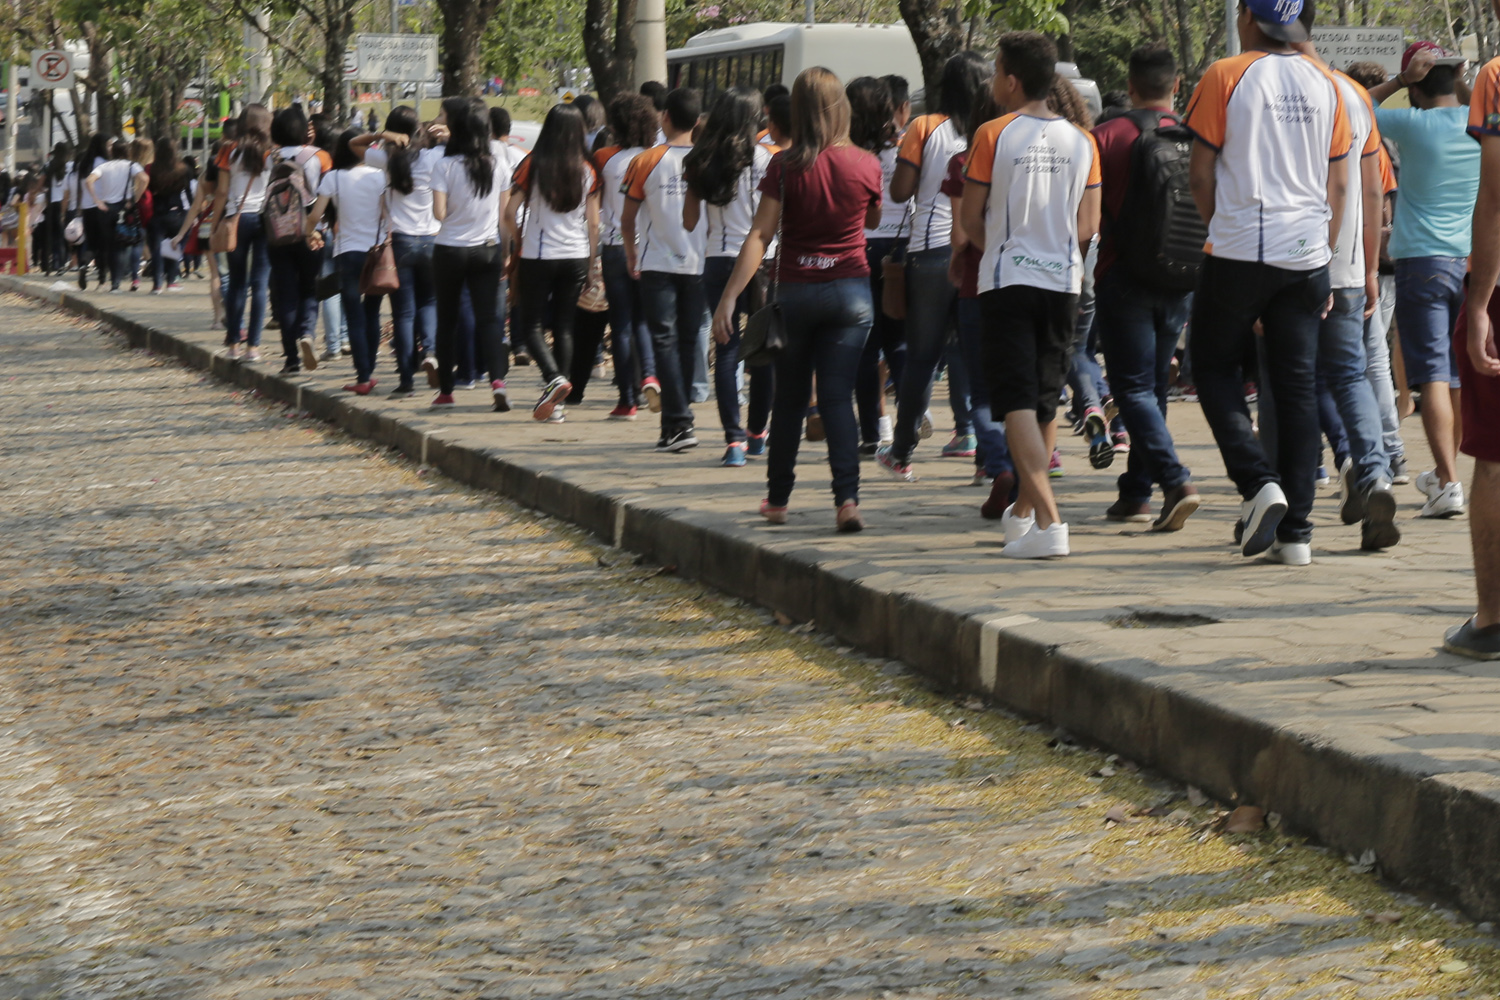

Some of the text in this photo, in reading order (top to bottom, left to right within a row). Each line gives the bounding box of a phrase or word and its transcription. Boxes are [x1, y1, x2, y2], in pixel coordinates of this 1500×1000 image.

[1311, 32, 1399, 43] AVESSIA ELEVADA
[1315, 45, 1397, 56] RA PEDESTRES
